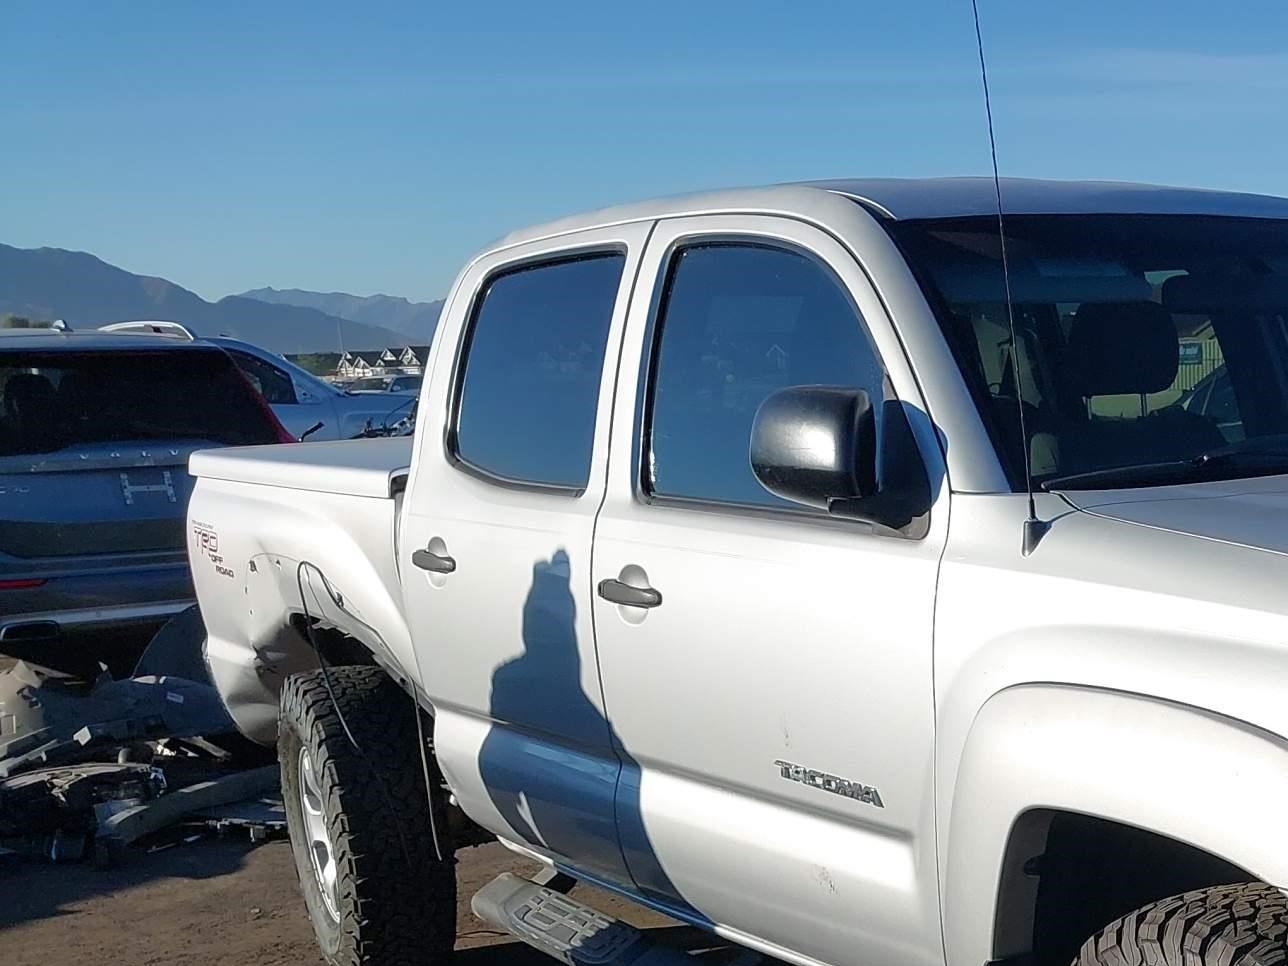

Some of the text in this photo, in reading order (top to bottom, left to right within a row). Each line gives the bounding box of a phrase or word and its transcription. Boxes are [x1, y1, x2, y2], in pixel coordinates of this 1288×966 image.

[193, 526, 218, 555] TRD
[215, 565, 235, 579] ROAD
[774, 760, 885, 809] TACOMA
